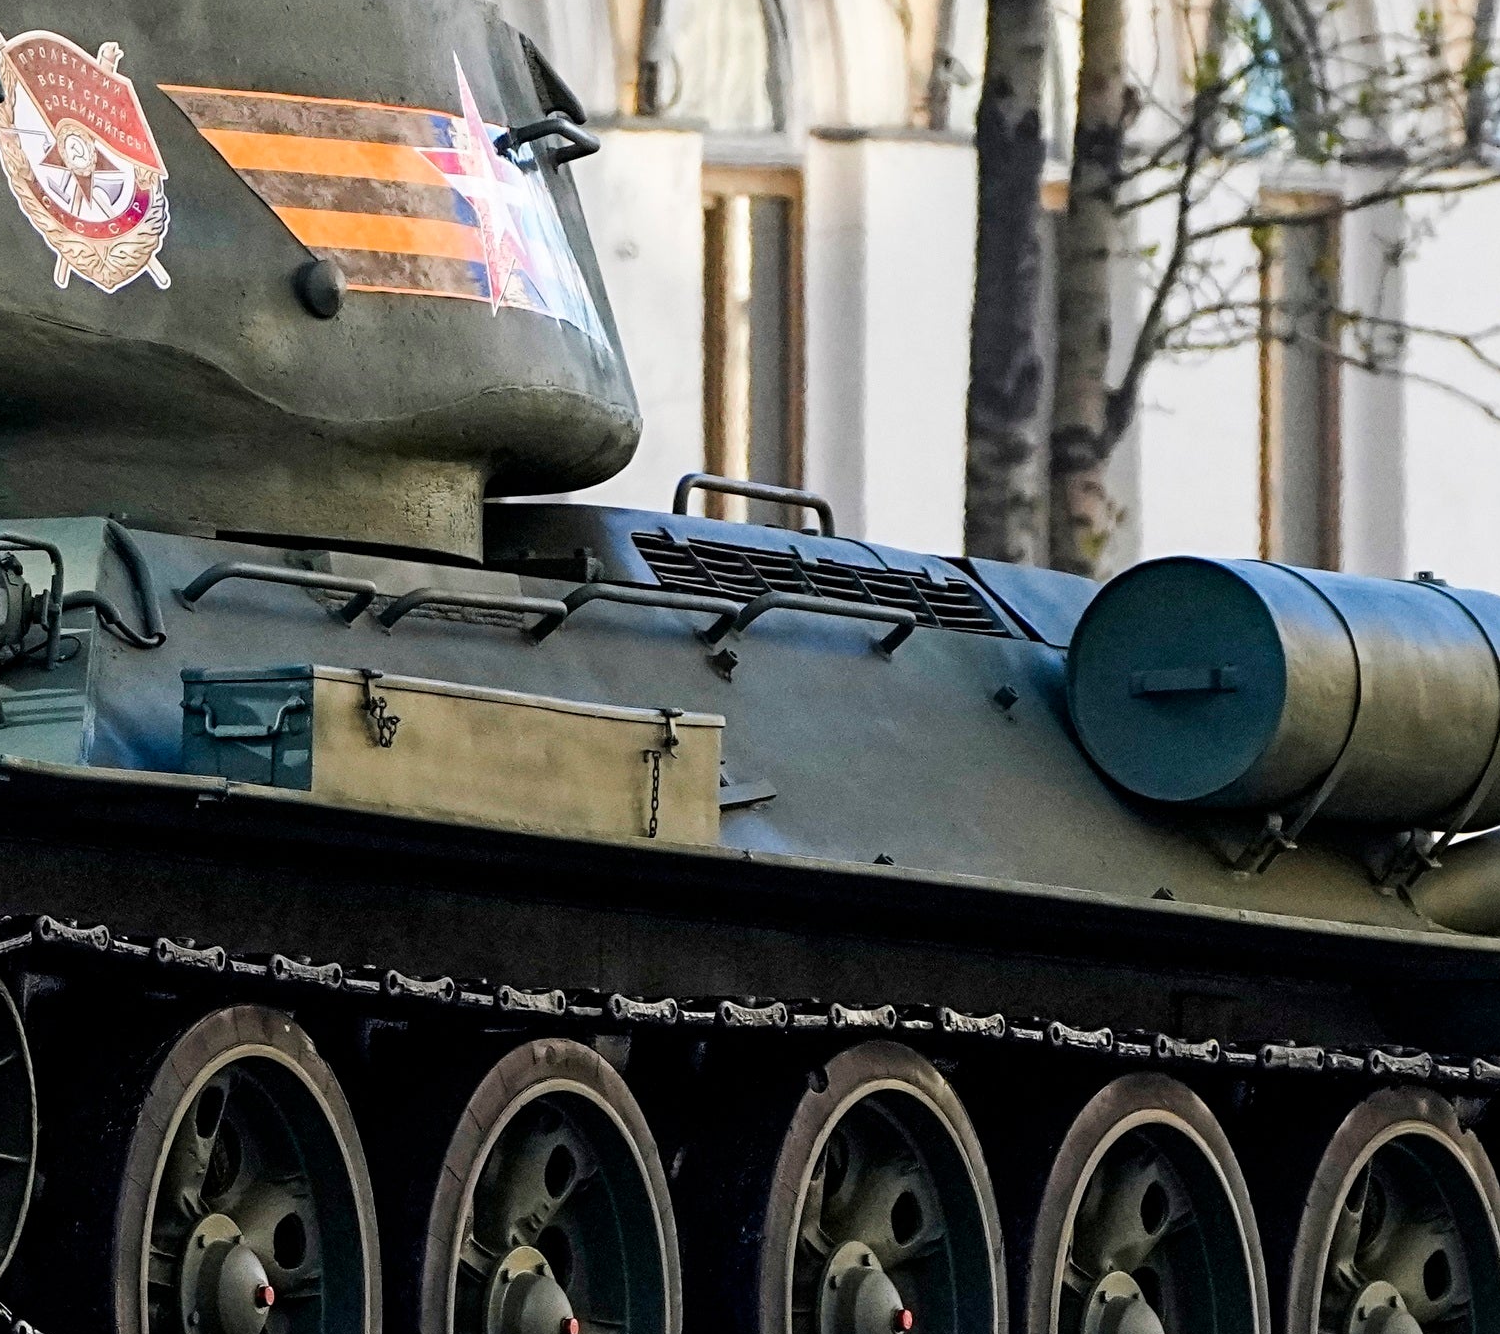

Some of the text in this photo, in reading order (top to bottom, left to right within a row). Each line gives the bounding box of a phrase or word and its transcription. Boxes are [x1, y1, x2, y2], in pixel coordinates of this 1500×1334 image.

[18, 46, 123, 97] ПРОЛЕТАРИИ
[37, 72, 75, 91] ВСЕХ
[44, 94, 148, 153] СОЕДИНЯЙТЕСЬ!
